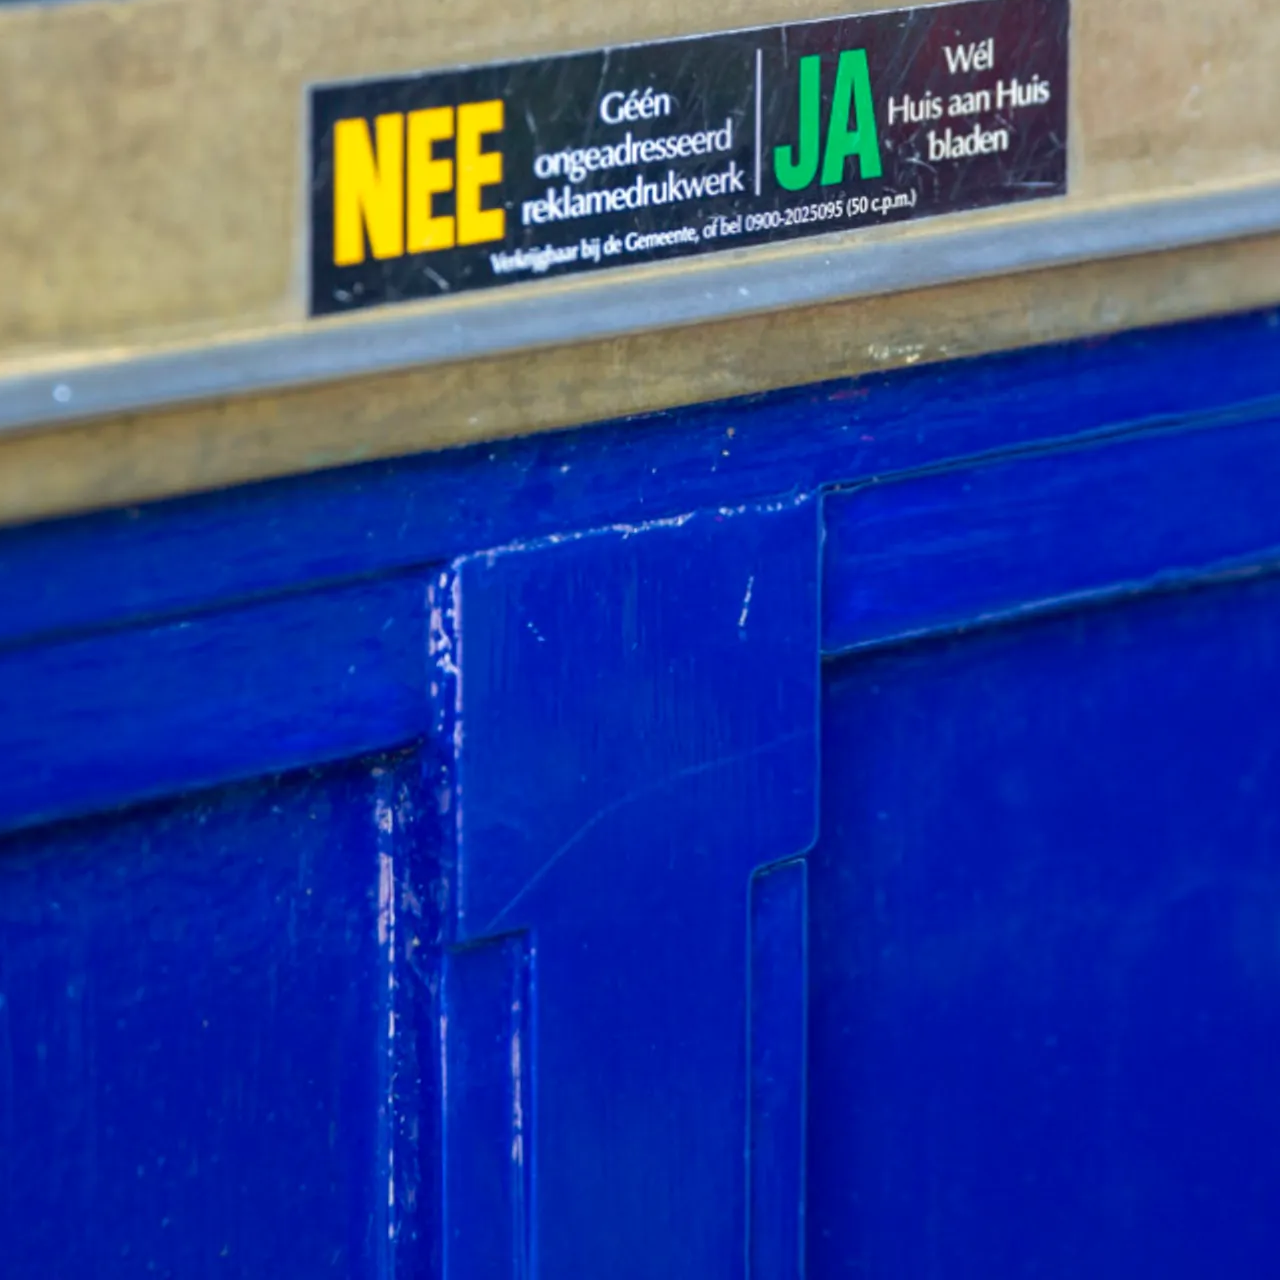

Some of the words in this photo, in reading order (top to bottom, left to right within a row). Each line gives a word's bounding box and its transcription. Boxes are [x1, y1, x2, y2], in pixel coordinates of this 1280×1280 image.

[942, 37, 995, 74] Wél
[600, 88, 670, 124] Géén
[773, 48, 883, 191] JA
[887, 92, 943, 125] Huis
[948, 89, 991, 116] aan
[995, 74, 1050, 109] Huis
[533, 119, 733, 182] ongeadresseerd
[927, 126, 1009, 162] bladen
[334, 99, 505, 267] NEE
[522, 161, 745, 225] reklamedrukwerk
[489, 244, 579, 274] Verkrijgbaar
[580, 237, 600, 263] bij
[603, 234, 622, 256] de
[624, 226, 700, 251] Gemeente,
[702, 217, 719, 240] of
[721, 215, 742, 237] bel
[745, 200, 843, 232] 0900-2025095
[846, 196, 869, 218] (50
[870, 188, 917, 215] c.p.m.)
